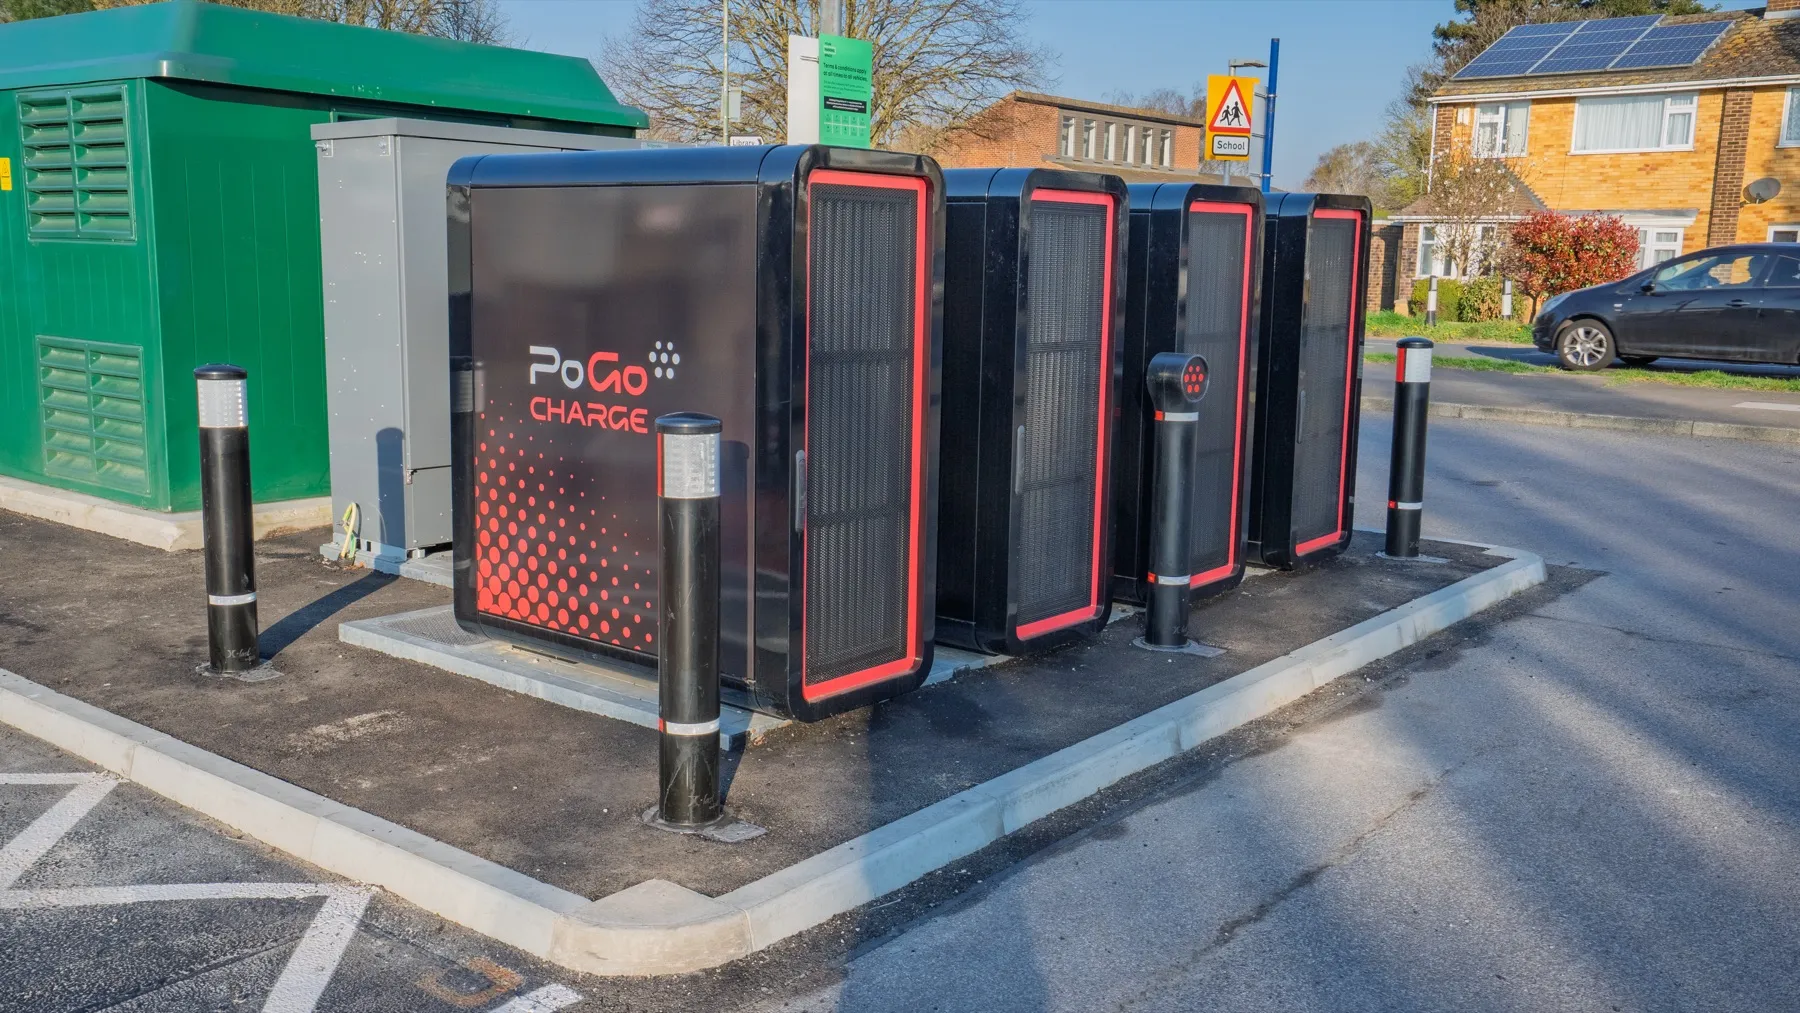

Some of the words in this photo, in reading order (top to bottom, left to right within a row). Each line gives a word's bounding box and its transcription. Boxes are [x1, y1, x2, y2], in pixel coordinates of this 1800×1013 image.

[1217, 140, 1245, 150] School
[529, 345, 648, 396] PoGo
[529, 396, 648, 434] CHARGE
